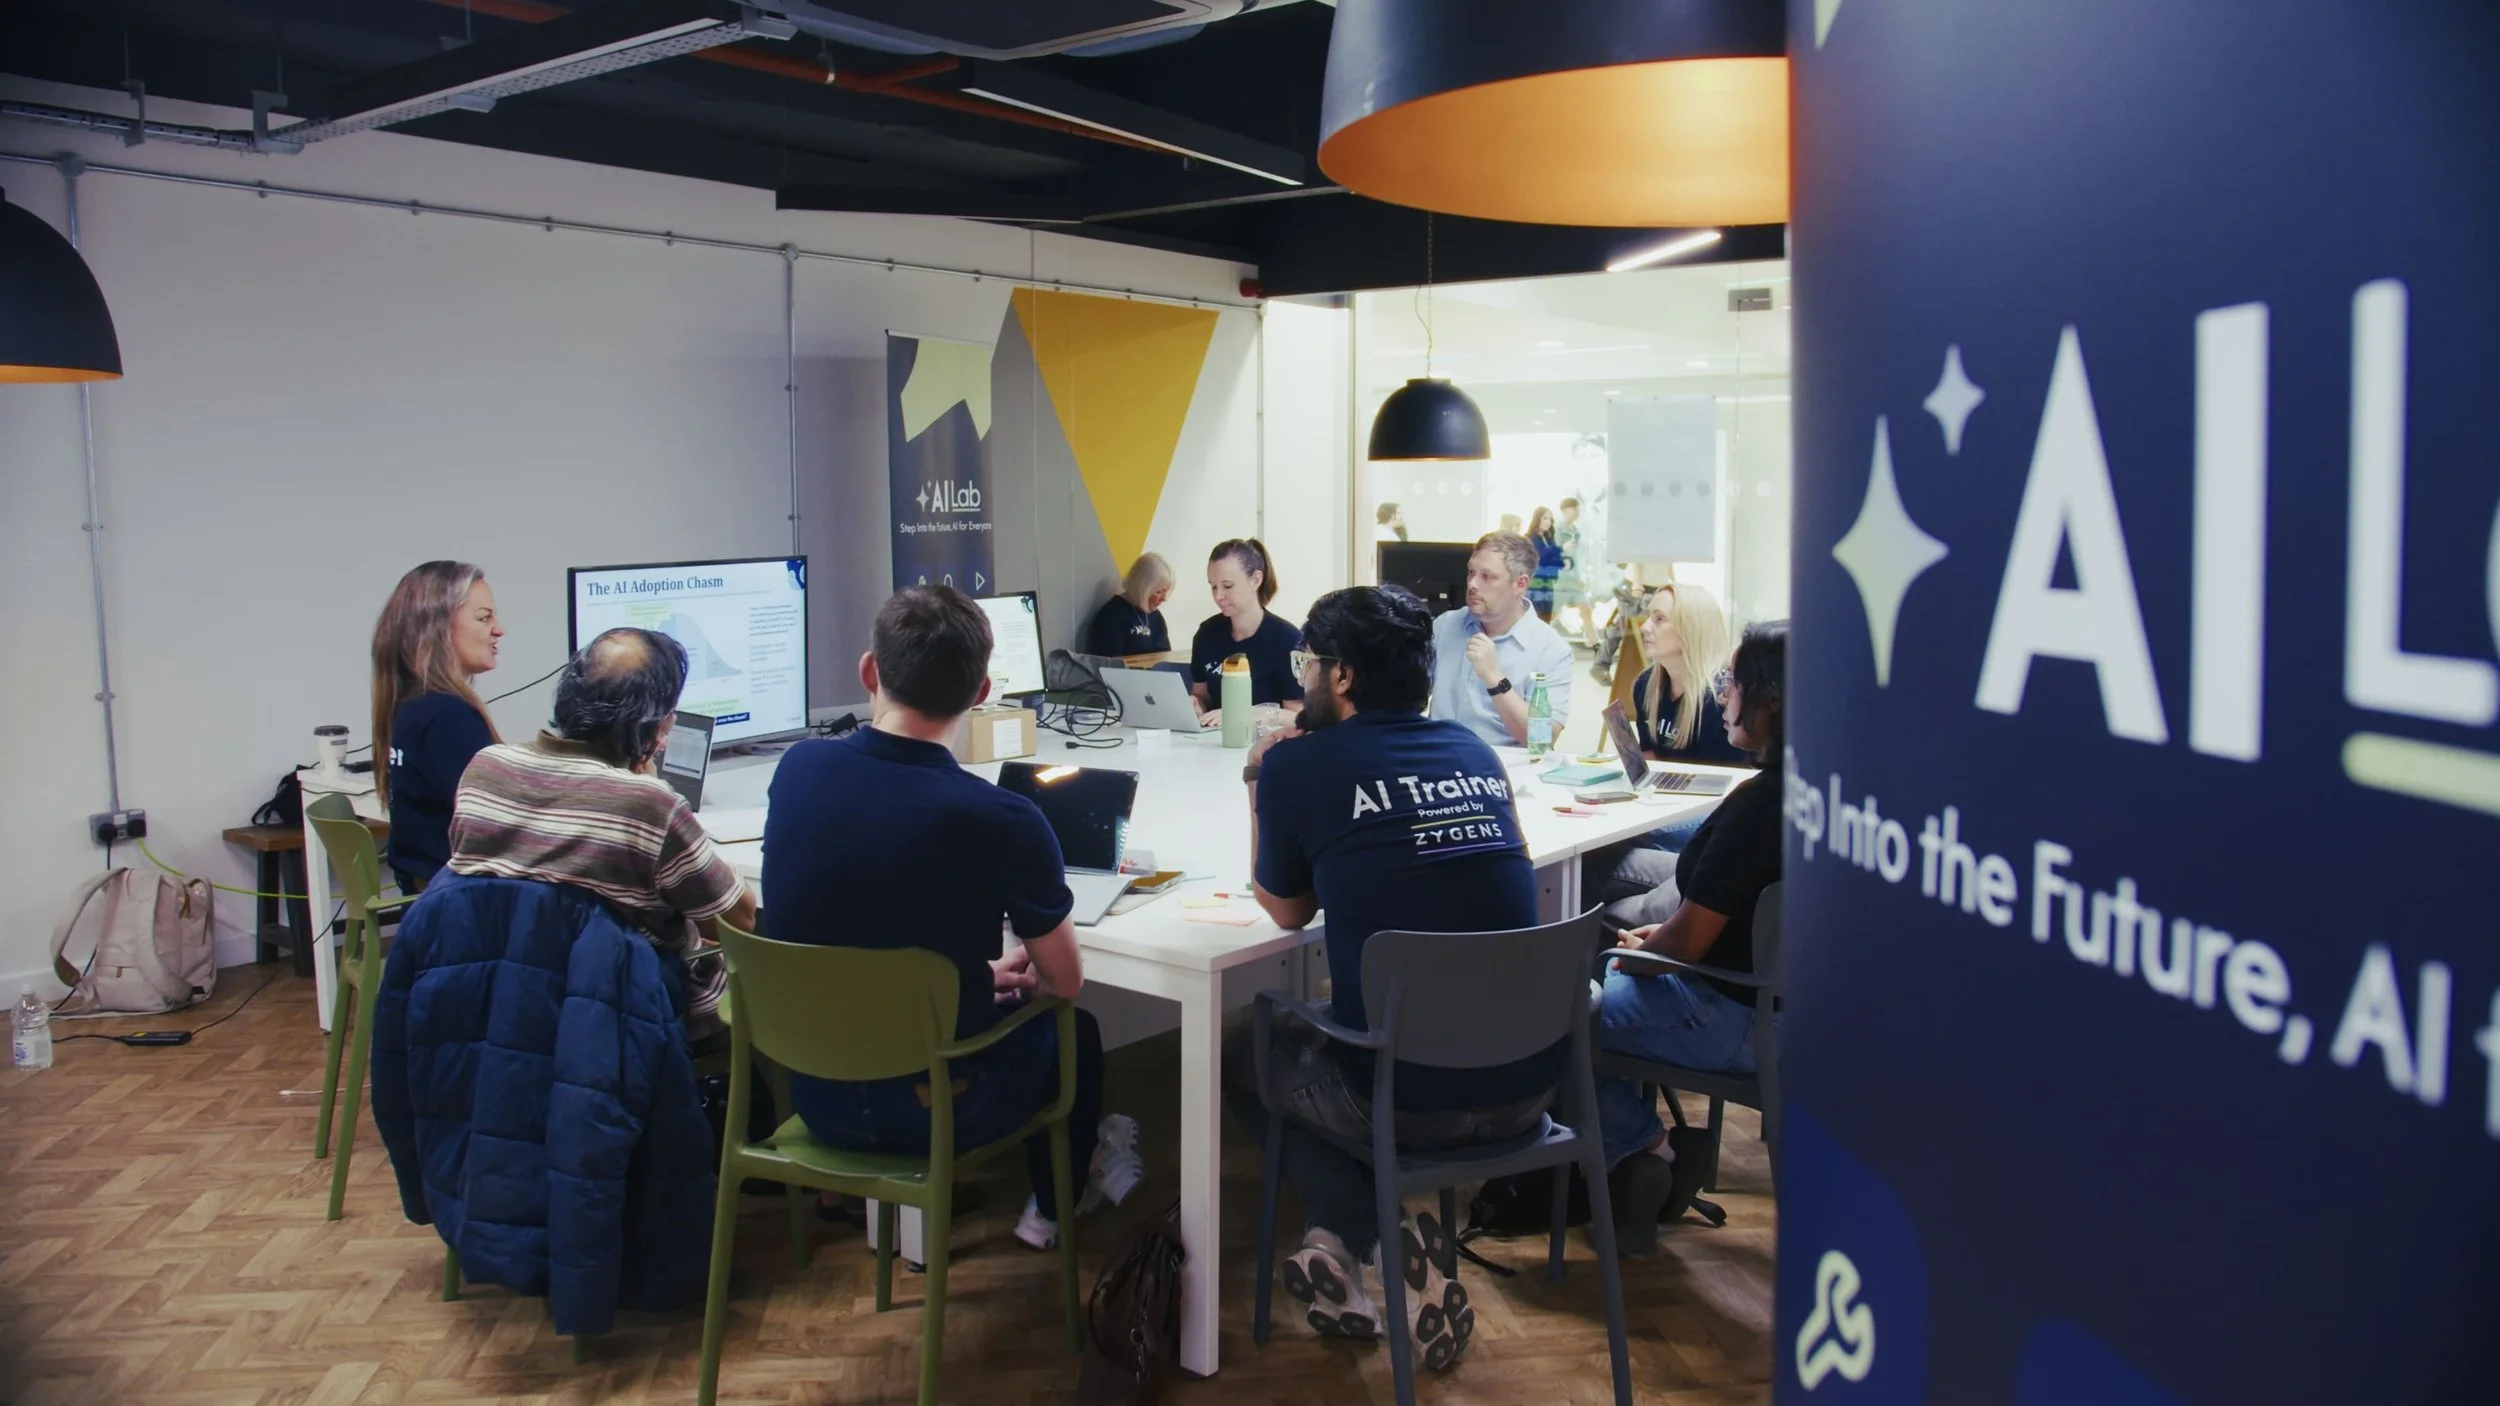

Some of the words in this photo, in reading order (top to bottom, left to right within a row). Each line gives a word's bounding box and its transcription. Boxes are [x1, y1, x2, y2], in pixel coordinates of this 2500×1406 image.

[932, 480, 949, 512] AI
[951, 480, 981, 507] Lab
[900, 523, 916, 535] Step
[917, 522, 928, 533] Into
[928, 521, 936, 532] the
[959, 520, 968, 531] for
[1974, 300, 2269, 763] AI
[2343, 277, 2500, 728] L
[587, 582, 610, 596] The
[613, 580, 627, 594] AI
[631, 578, 684, 595] Adoption
[687, 576, 724, 590] Chasm
[1353, 780, 1392, 820] AI
[1398, 771, 1509, 804] Trainer
[1417, 802, 1469, 818] Powered
[1470, 801, 1484, 813] by
[1414, 823, 1503, 846] ZYGENS
[1828, 772, 1910, 883] Into
[1918, 805, 2017, 927] the
[2032, 840, 2313, 1065] Future,
[2330, 942, 2452, 1106] AI
